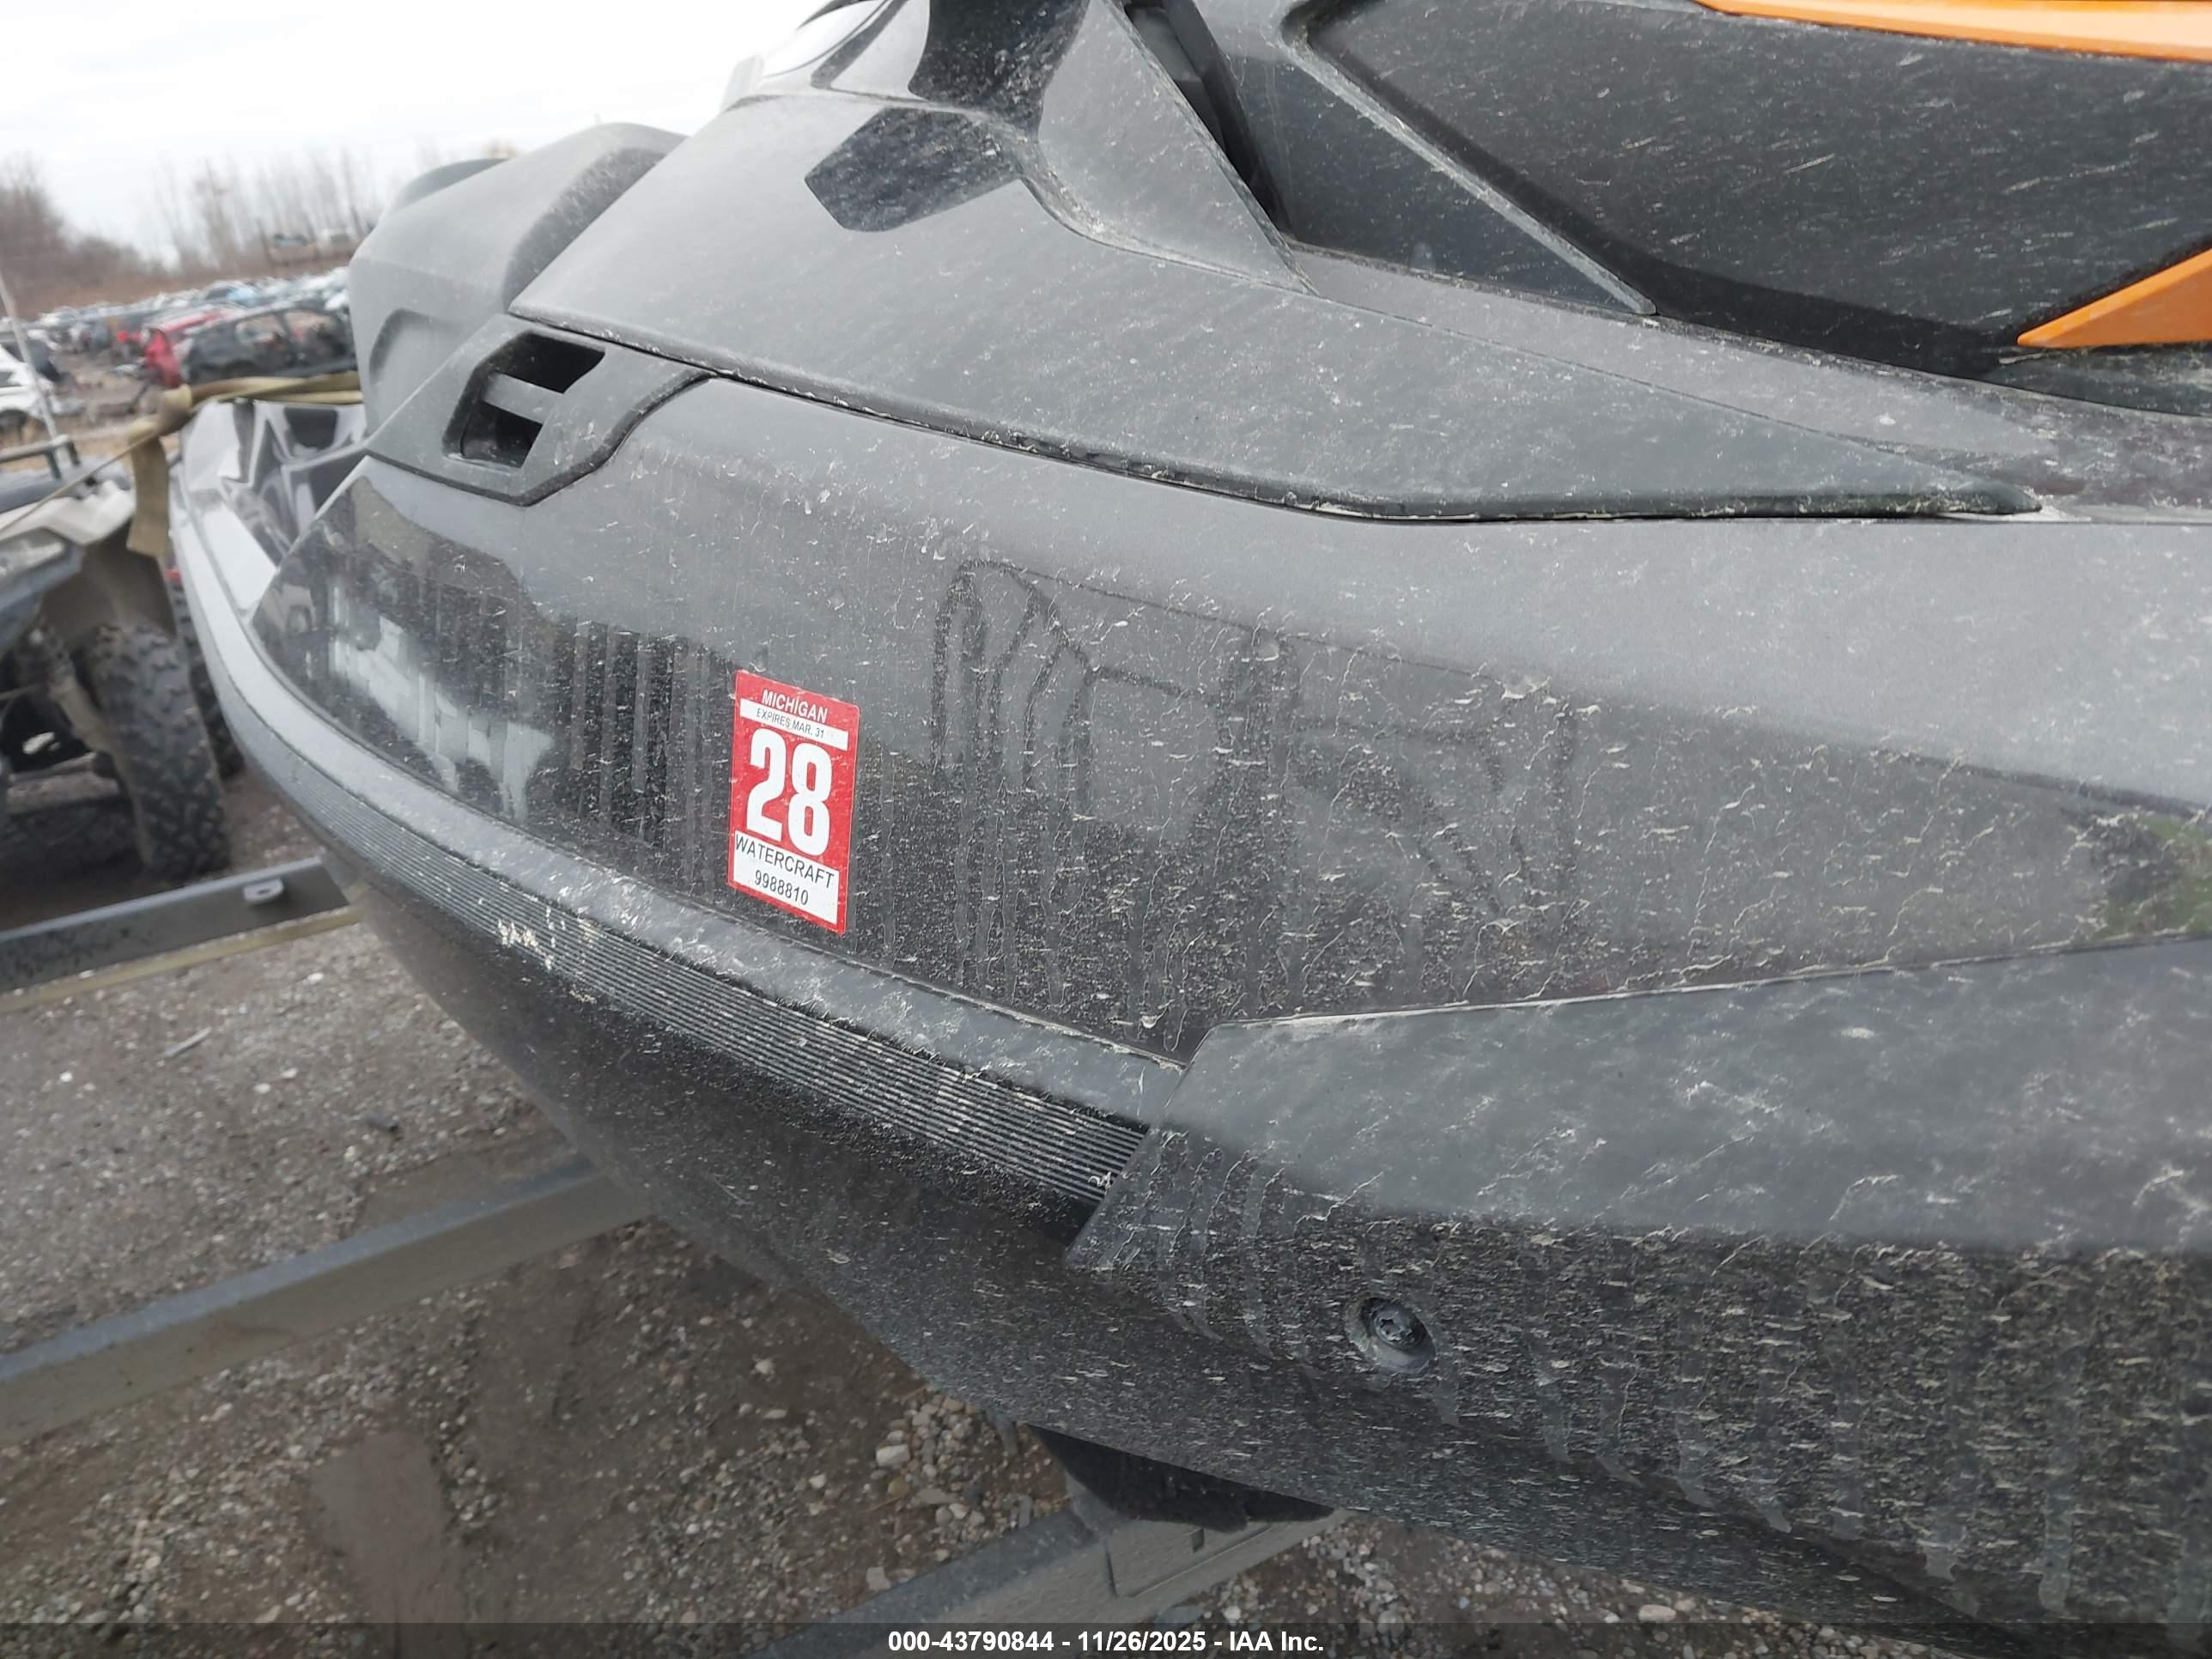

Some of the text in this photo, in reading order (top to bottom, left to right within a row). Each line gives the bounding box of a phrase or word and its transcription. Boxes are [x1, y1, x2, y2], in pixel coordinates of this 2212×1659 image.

[757, 708, 824, 738] EXPIRES MAR. 31
[762, 690, 828, 724] MICHIGAN
[746, 727, 832, 856] 28
[736, 833, 835, 889] WATERCRAFT
[755, 869, 810, 906] 9988810
